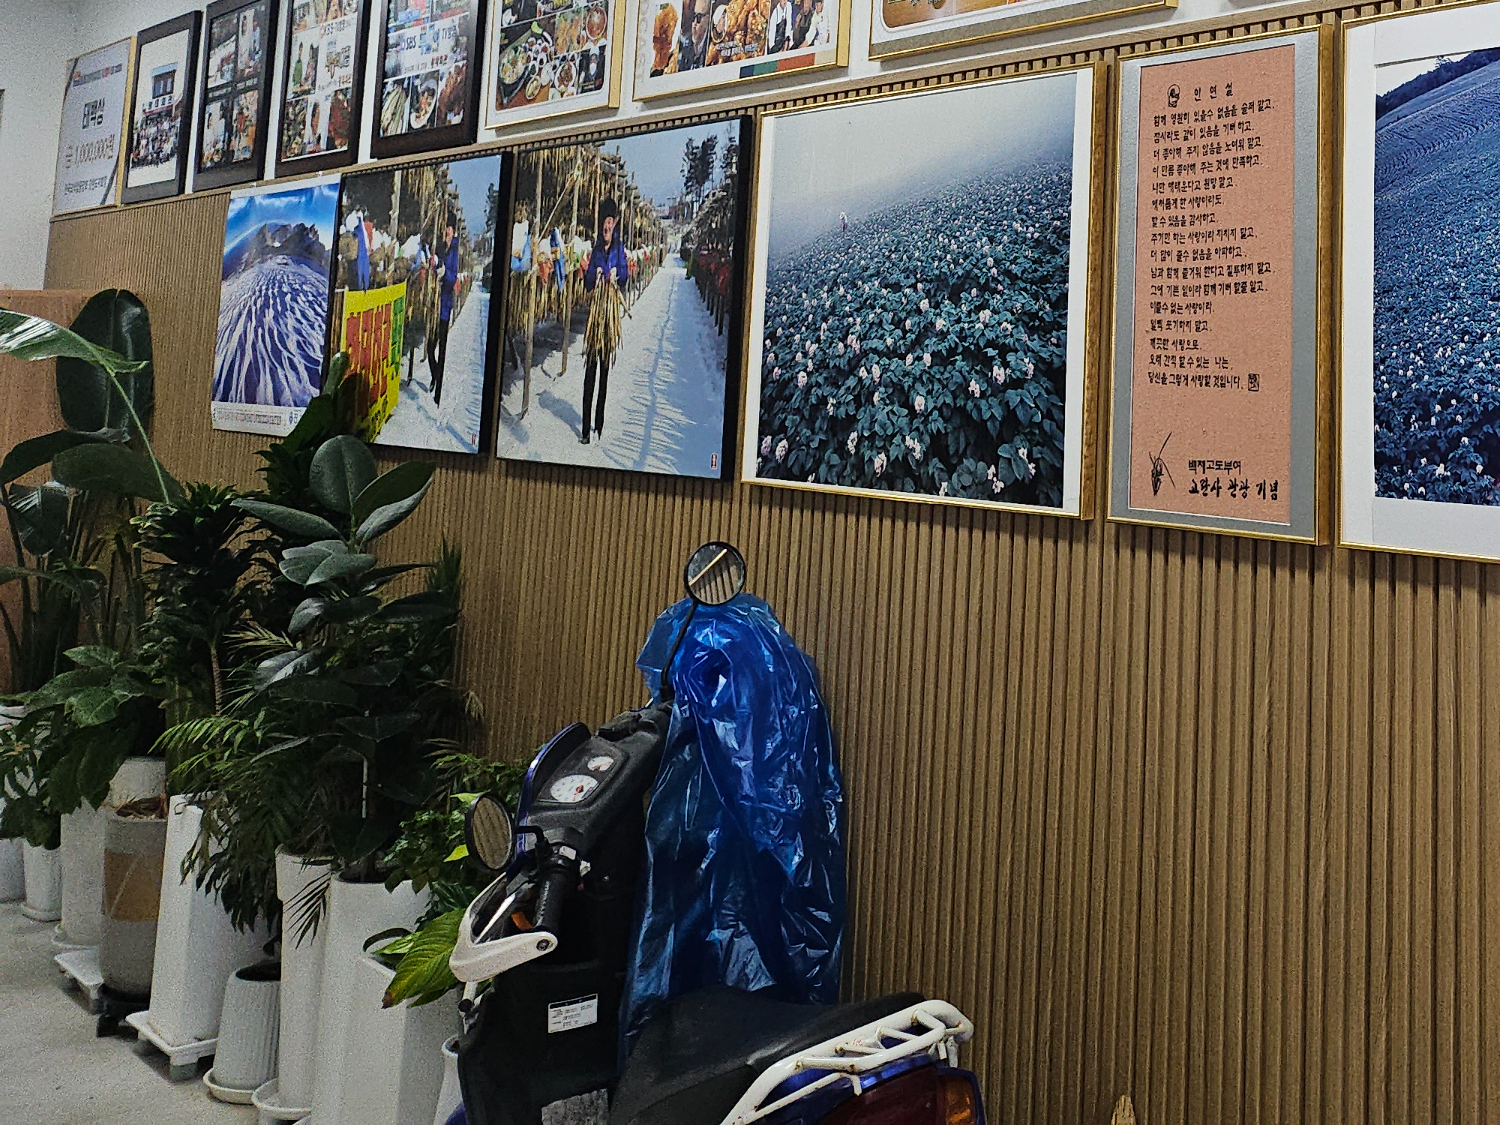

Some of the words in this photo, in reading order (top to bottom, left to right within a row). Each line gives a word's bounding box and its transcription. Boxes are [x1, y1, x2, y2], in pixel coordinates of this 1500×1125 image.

[1171, 112, 1190, 125] 영원히
[1218, 105, 1237, 119] 없음을
[1154, 130, 1179, 143] 잠시라도
[1183, 128, 1196, 141] 같이
[1200, 125, 1219, 139] 있음을
[1154, 149, 1159, 161] 더
[1186, 146, 1199, 157] 주지
[1200, 161, 1213, 173] 주는
[1151, 233, 1170, 245] 주기만
[1173, 233, 1186, 245] 하는
[1188, 231, 1214, 244] 사랑이라
[1193, 248, 1212, 261] 없음을
[1170, 302, 1183, 315] 없는
[1149, 354, 1161, 366] 오래
[1148, 372, 1167, 385] 당신을
[1169, 374, 1188, 387] 그렇게
[1191, 374, 1211, 387] 사랑할
[1189, 460, 1241, 475] 백제고도부여
[1189, 477, 1222, 497] 고란사
[1228, 477, 1249, 499] 관광
